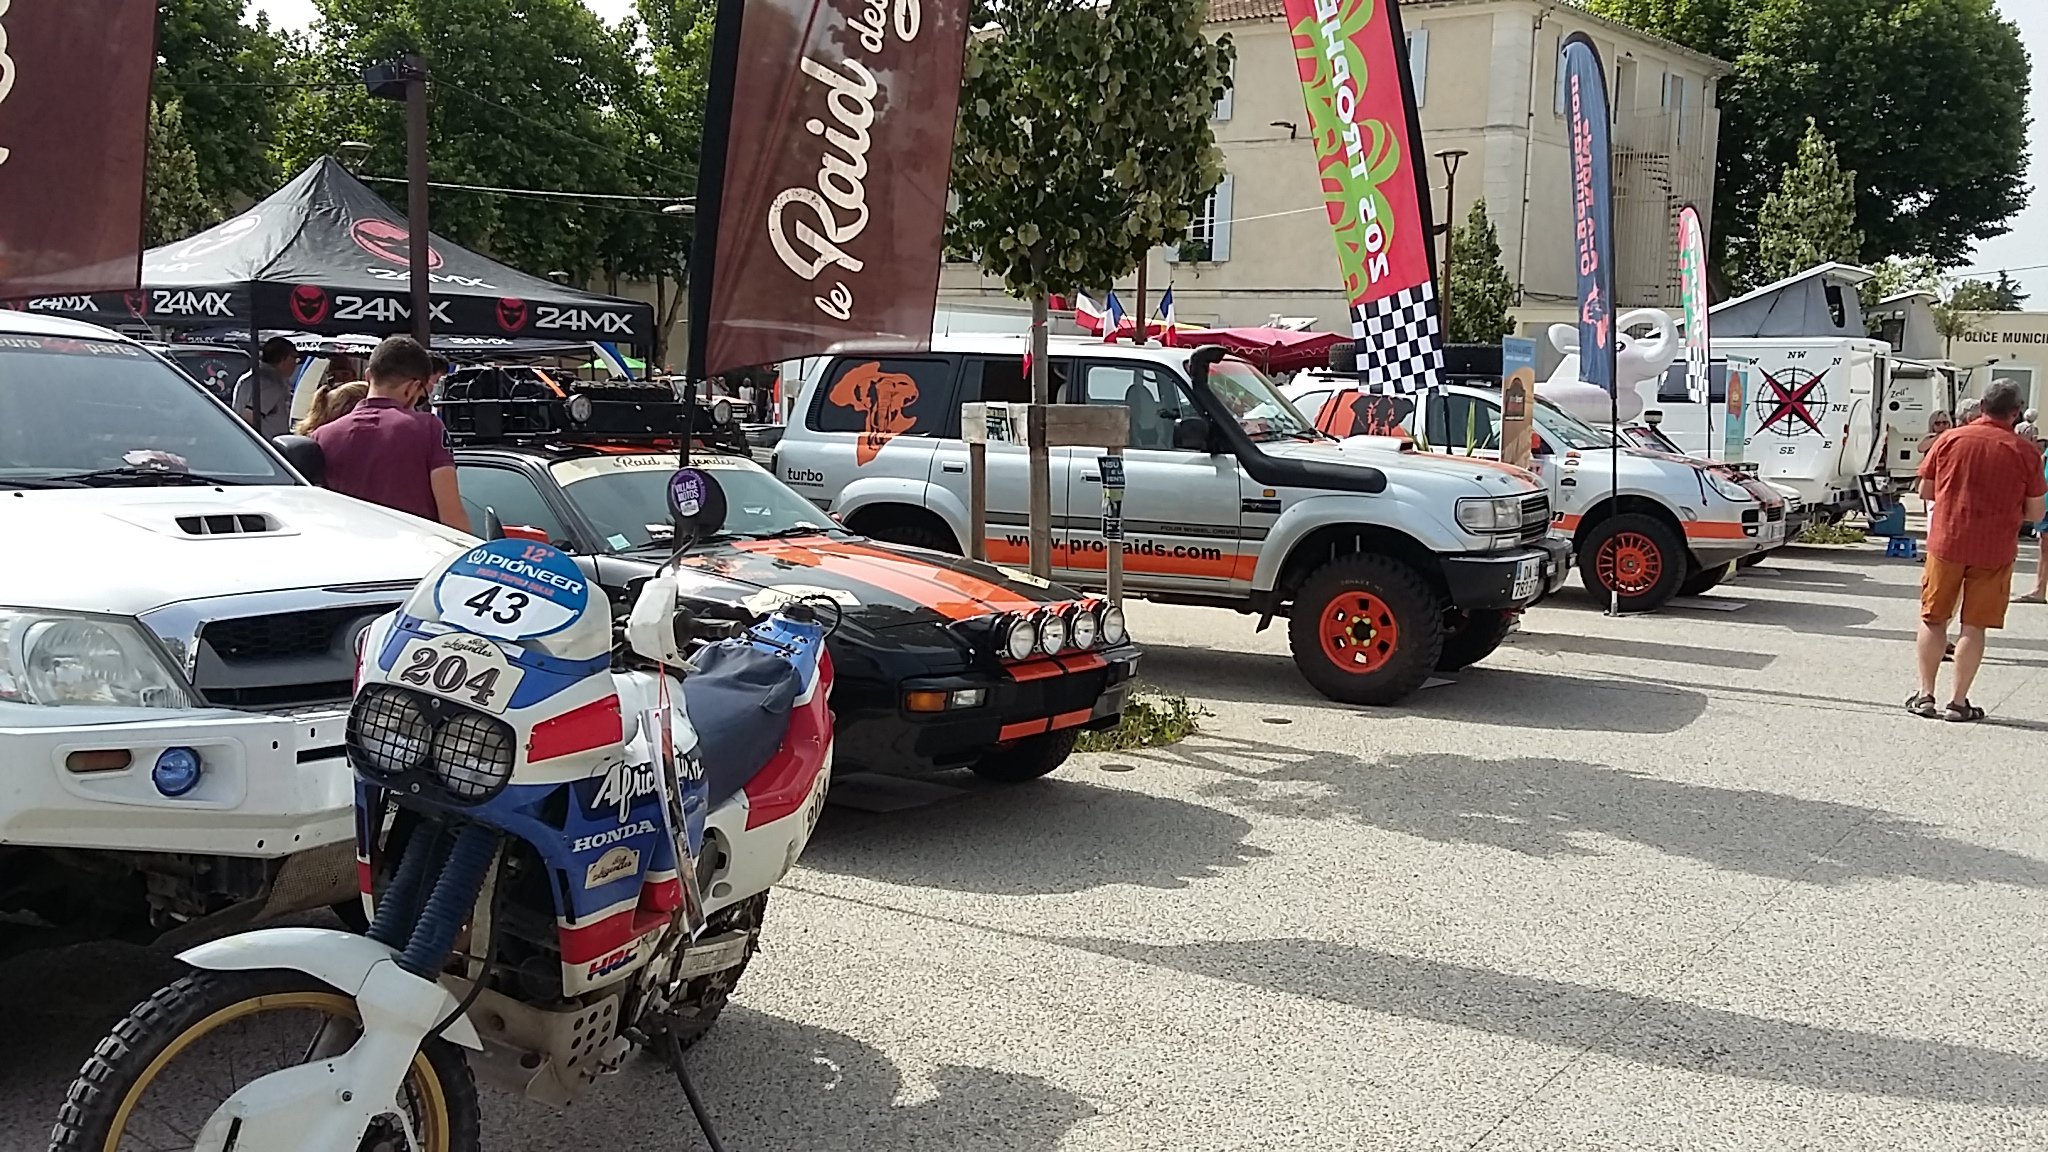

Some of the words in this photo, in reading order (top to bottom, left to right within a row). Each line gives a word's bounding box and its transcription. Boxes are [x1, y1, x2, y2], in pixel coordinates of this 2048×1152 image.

[767, 56, 878, 280] Raid
[153, 290, 235, 317] 24MX
[334, 295, 454, 325] 24MX
[814, 281, 853, 320] le
[536, 306, 635, 336] 24MX
[1956, 331, 1998, 343] POLICE
[1748, 357, 1759, 365] W
[1787, 351, 1807, 359] NW
[1832, 357, 1842, 365] N
[1832, 404, 1848, 412] NE
[1779, 446, 1795, 455] SE
[1823, 441, 1832, 449] E
[786, 467, 824, 482] turbo
[485, 554, 585, 595] PIONEER
[464, 585, 530, 625] 43
[400, 647, 501, 706] 204
[590, 759, 659, 823] Afric
[572, 819, 657, 852] HONDA
